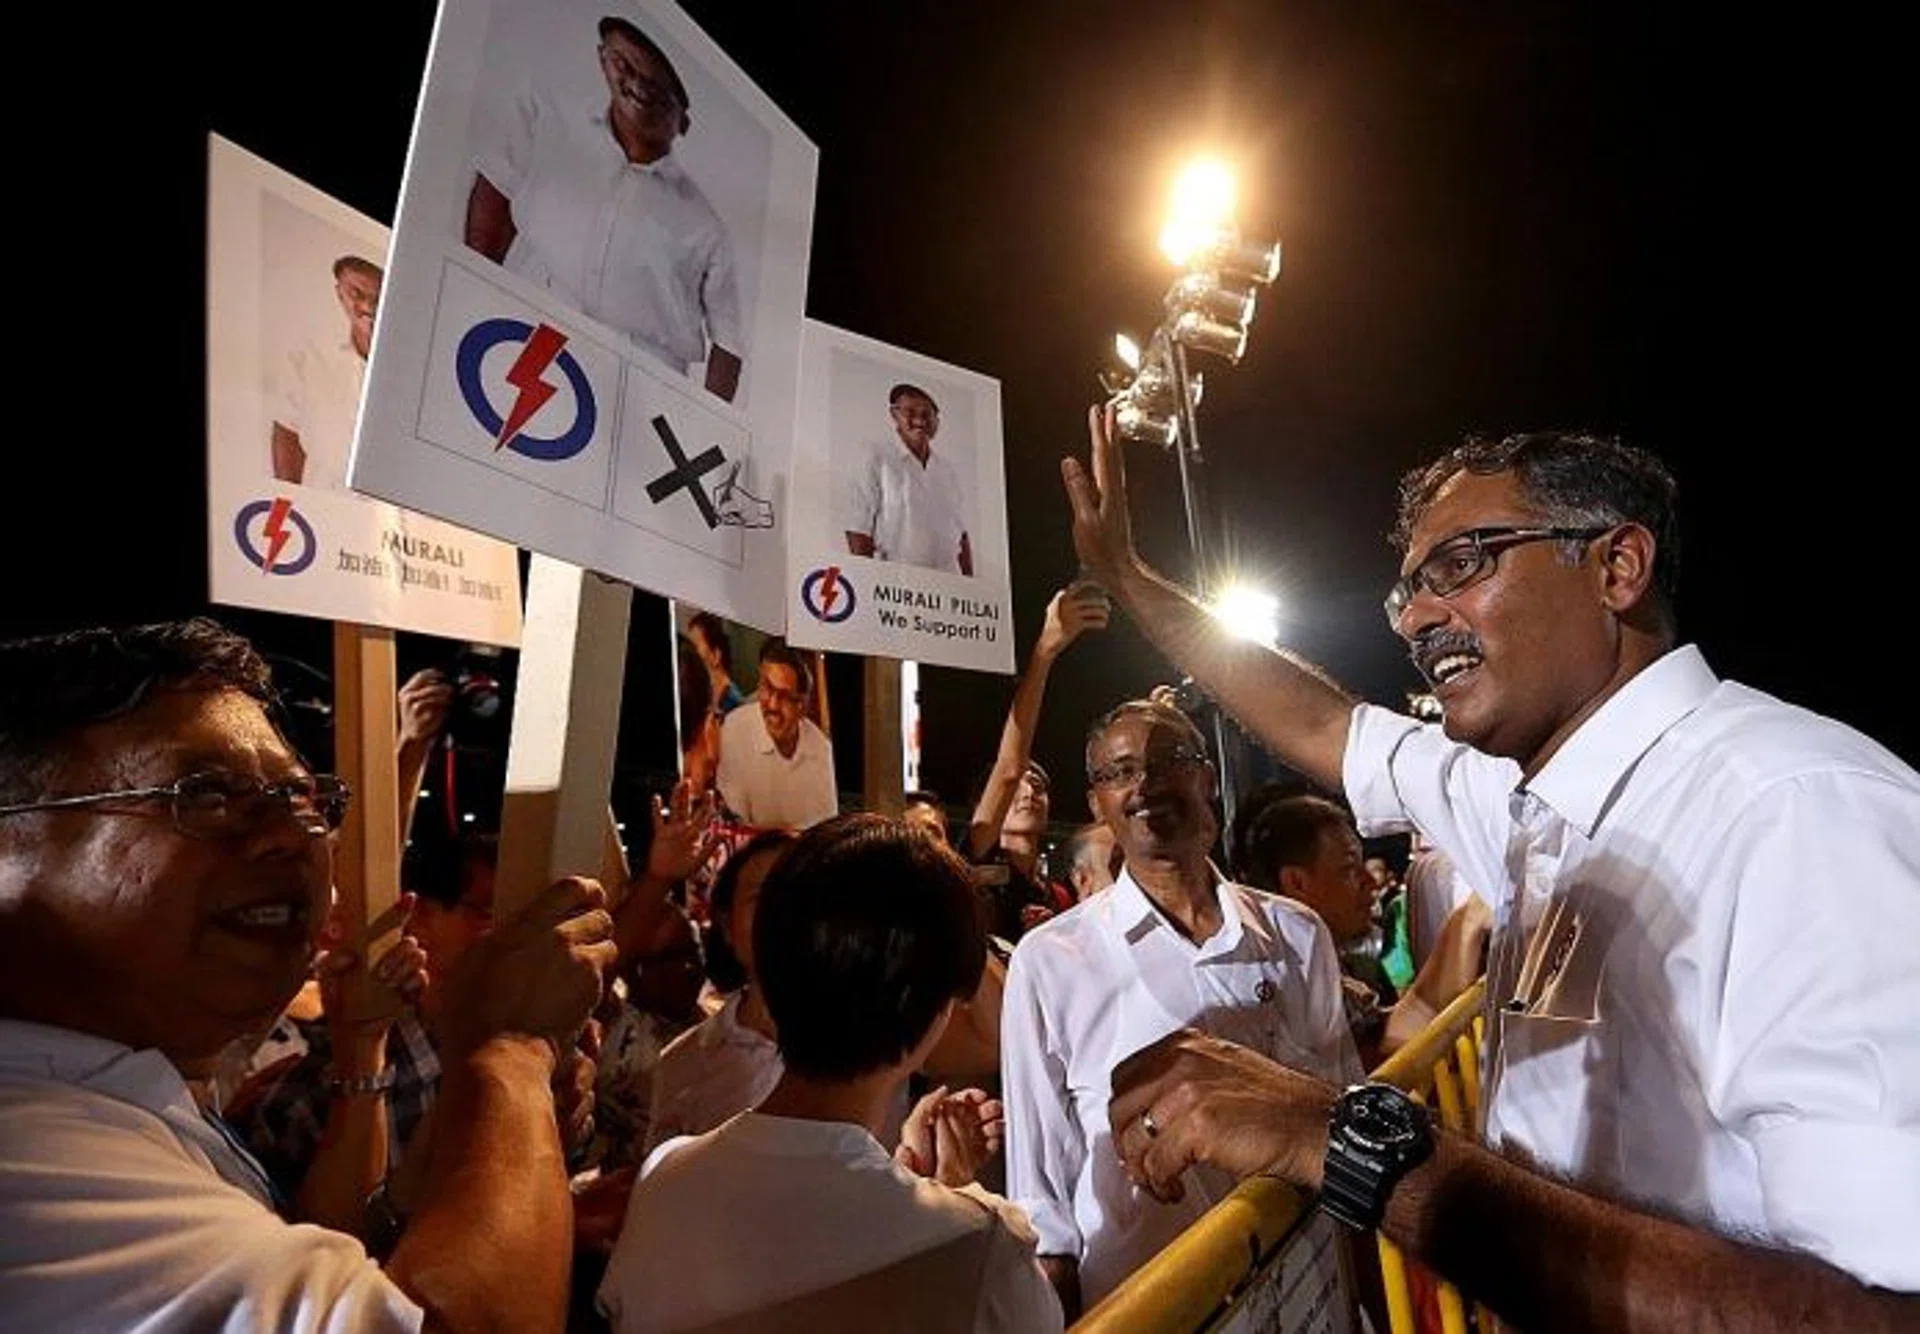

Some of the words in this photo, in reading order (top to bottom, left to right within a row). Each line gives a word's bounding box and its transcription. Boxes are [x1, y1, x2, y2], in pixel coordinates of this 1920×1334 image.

[381, 530, 464, 567] MURALI
[873, 584, 942, 610] MURALI
[951, 596, 999, 620] PILLAI
[878, 608, 908, 629] We
[914, 615, 980, 640] Support
[986, 626, 997, 642] U
